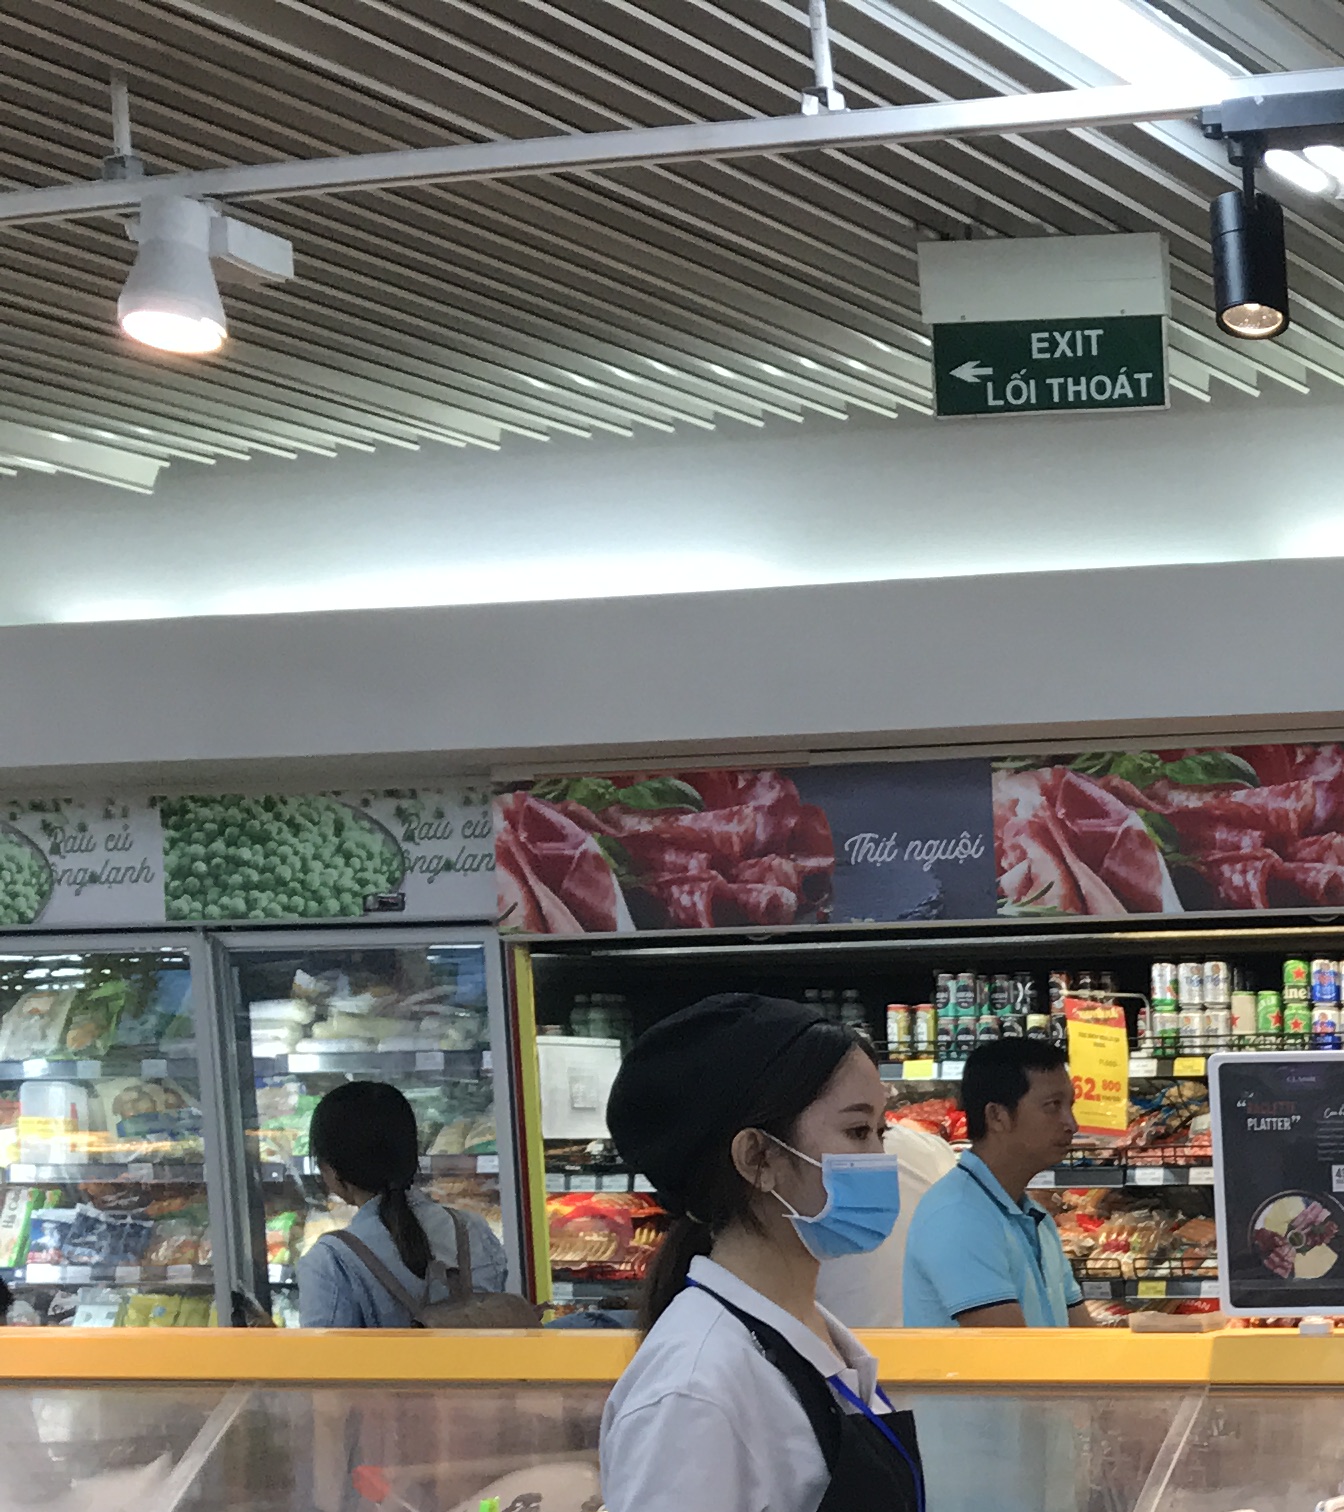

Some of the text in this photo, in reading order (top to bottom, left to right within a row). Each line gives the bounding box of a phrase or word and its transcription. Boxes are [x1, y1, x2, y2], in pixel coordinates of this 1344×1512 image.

[1031, 329, 1104, 359] EXIT
[987, 367, 1153, 406] LỐI THOÁT
[401, 849, 446, 878] ông
[844, 831, 984, 868] Thịt nguội
